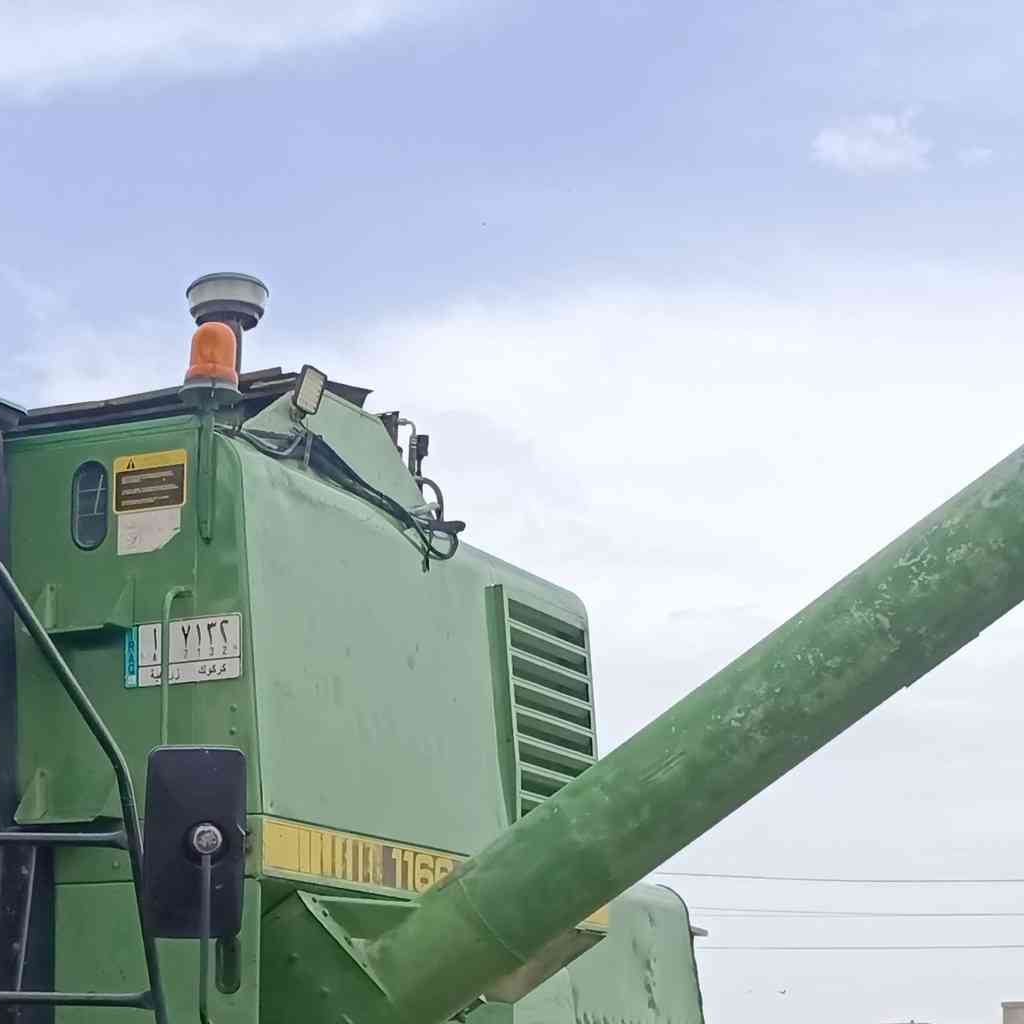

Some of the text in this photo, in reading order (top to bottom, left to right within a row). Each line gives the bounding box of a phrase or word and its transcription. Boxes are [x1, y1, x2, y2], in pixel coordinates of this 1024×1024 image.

[181, 619, 229, 649] ٧١٣٢
[127, 628, 136, 675] IRAQ
[150, 664, 227, 683] كركوك زرية
